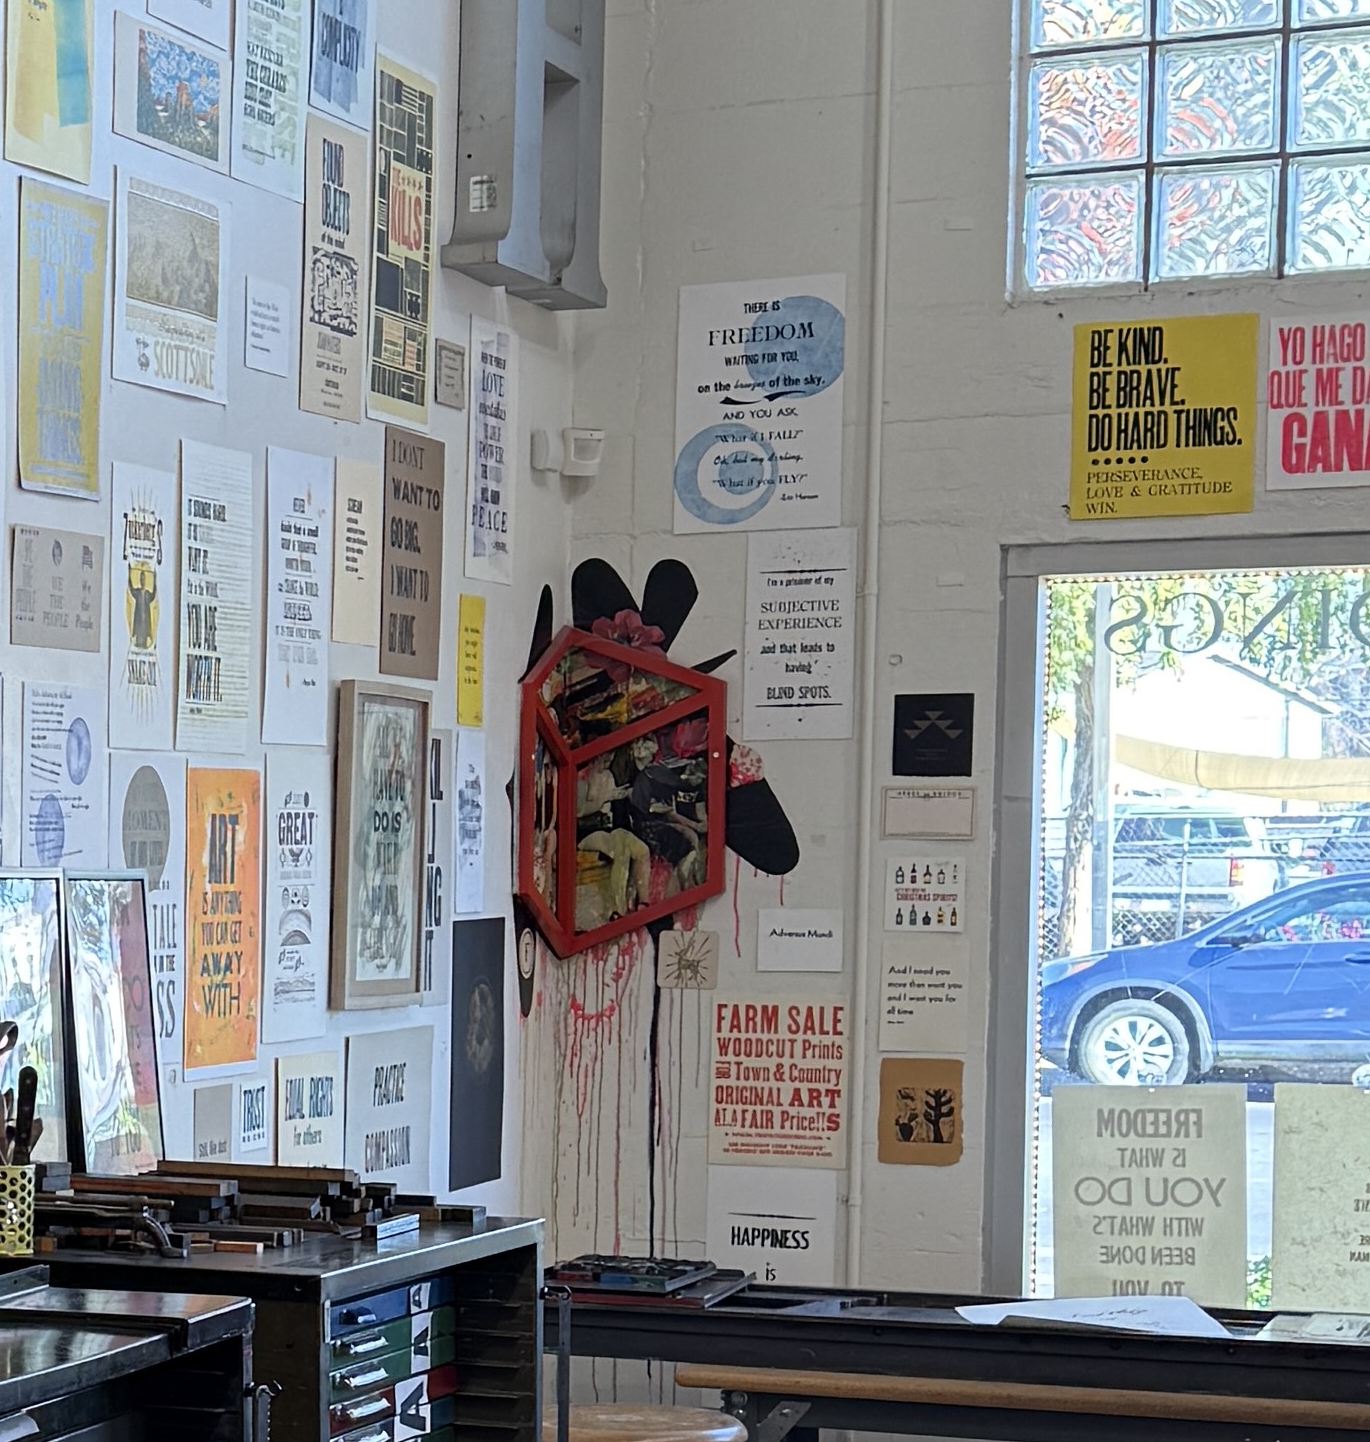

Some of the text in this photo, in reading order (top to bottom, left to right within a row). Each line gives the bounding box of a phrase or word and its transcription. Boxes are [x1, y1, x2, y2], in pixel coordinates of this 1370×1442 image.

[709, 321, 815, 347] FREEDOM
[1090, 326, 1168, 368] BE KIND.
[1278, 323, 1365, 366] YO HAGO
[1089, 367, 1185, 410] BE BRAVE.
[1088, 407, 1242, 452] DO HARD THINGS.
[1087, 481, 1232, 499] LOVE GRATITUDE
[758, 617, 842, 630] EXPERIENCE
[278, 810, 315, 847] GREAT
[208, 814, 239, 886] ART
[716, 1005, 844, 1036] FARM SALE
[717, 1038, 843, 1060] WOODCUT Prints
[734, 1062, 842, 1085] Town Country
[715, 1085, 841, 1108] ORIGINAL ART
[731, 1226, 809, 1249] HAPPINESS
